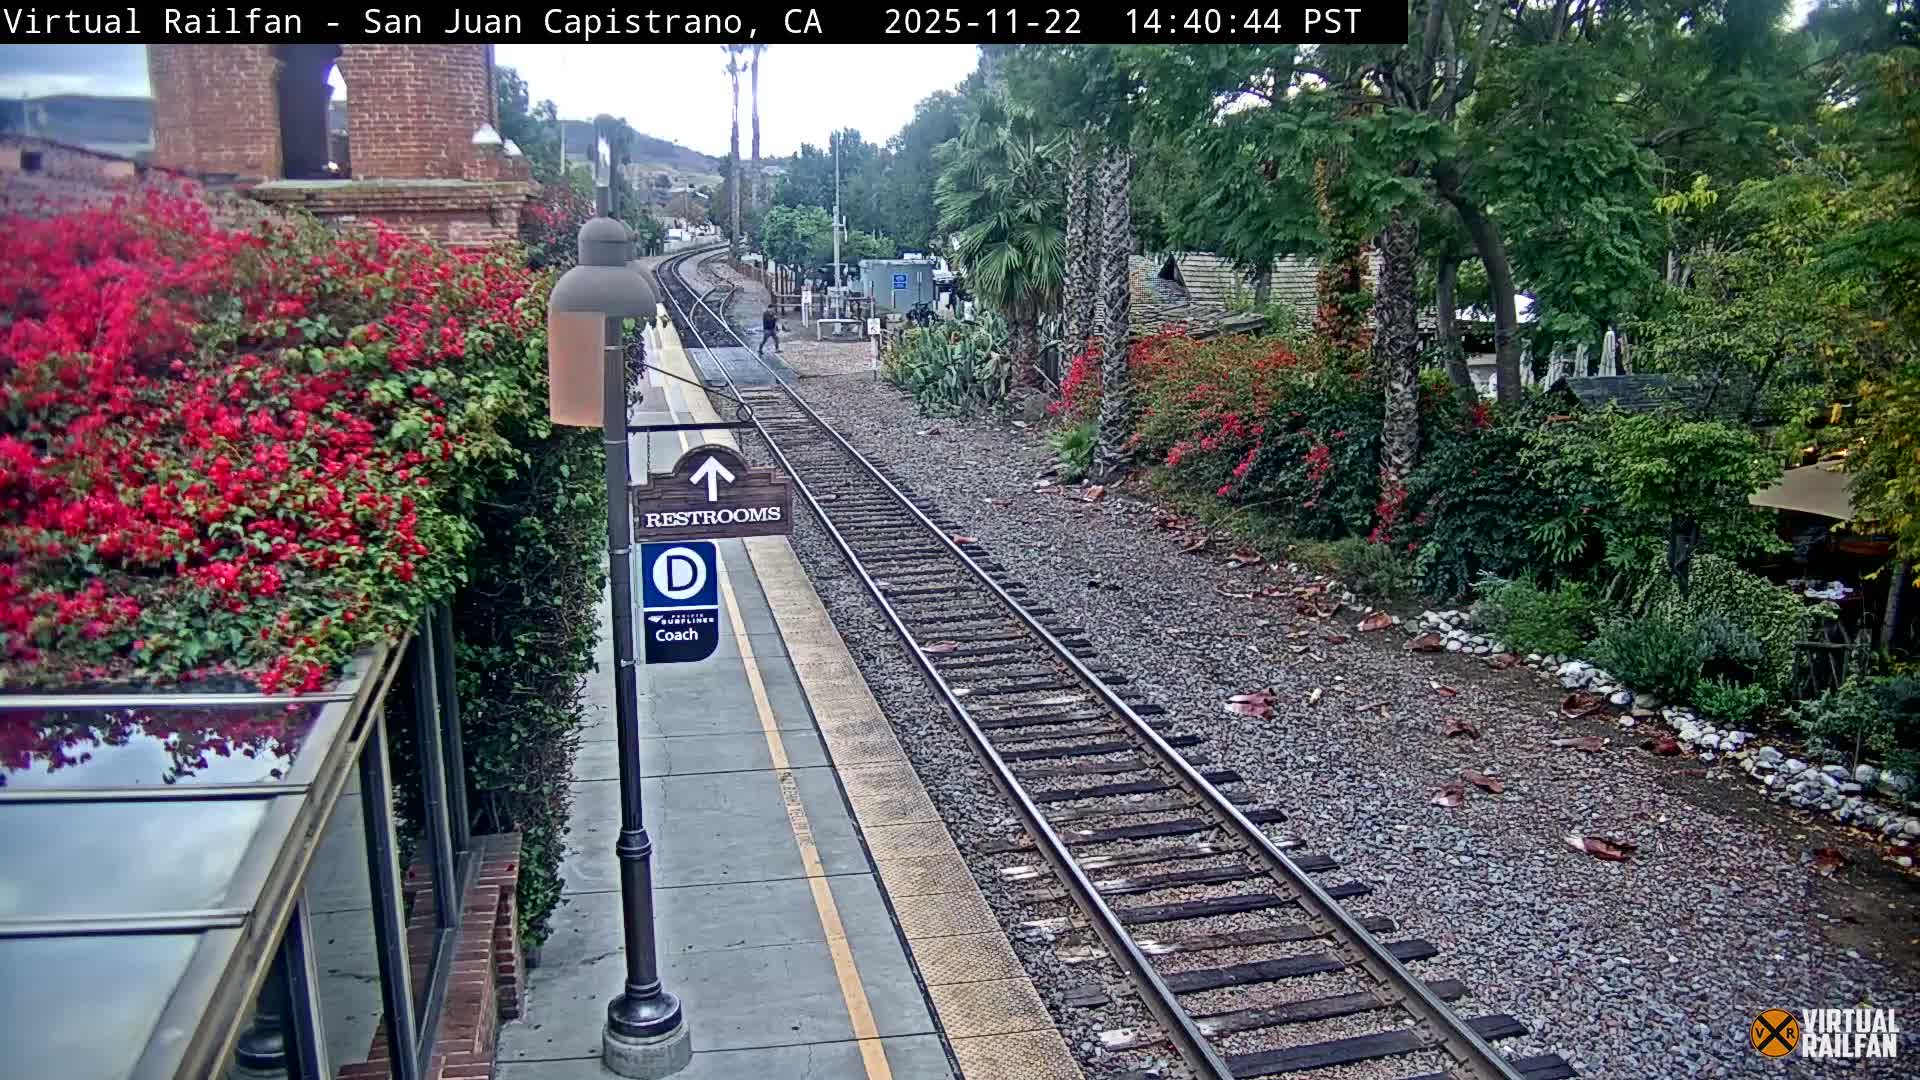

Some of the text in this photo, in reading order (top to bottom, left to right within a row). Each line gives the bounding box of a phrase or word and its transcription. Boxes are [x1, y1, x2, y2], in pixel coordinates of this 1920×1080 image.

[645, 506, 781, 528] RESTROOMS
[666, 554, 698, 592] D
[661, 617, 715, 625] SURFLINER
[656, 627, 698, 642] Coach
